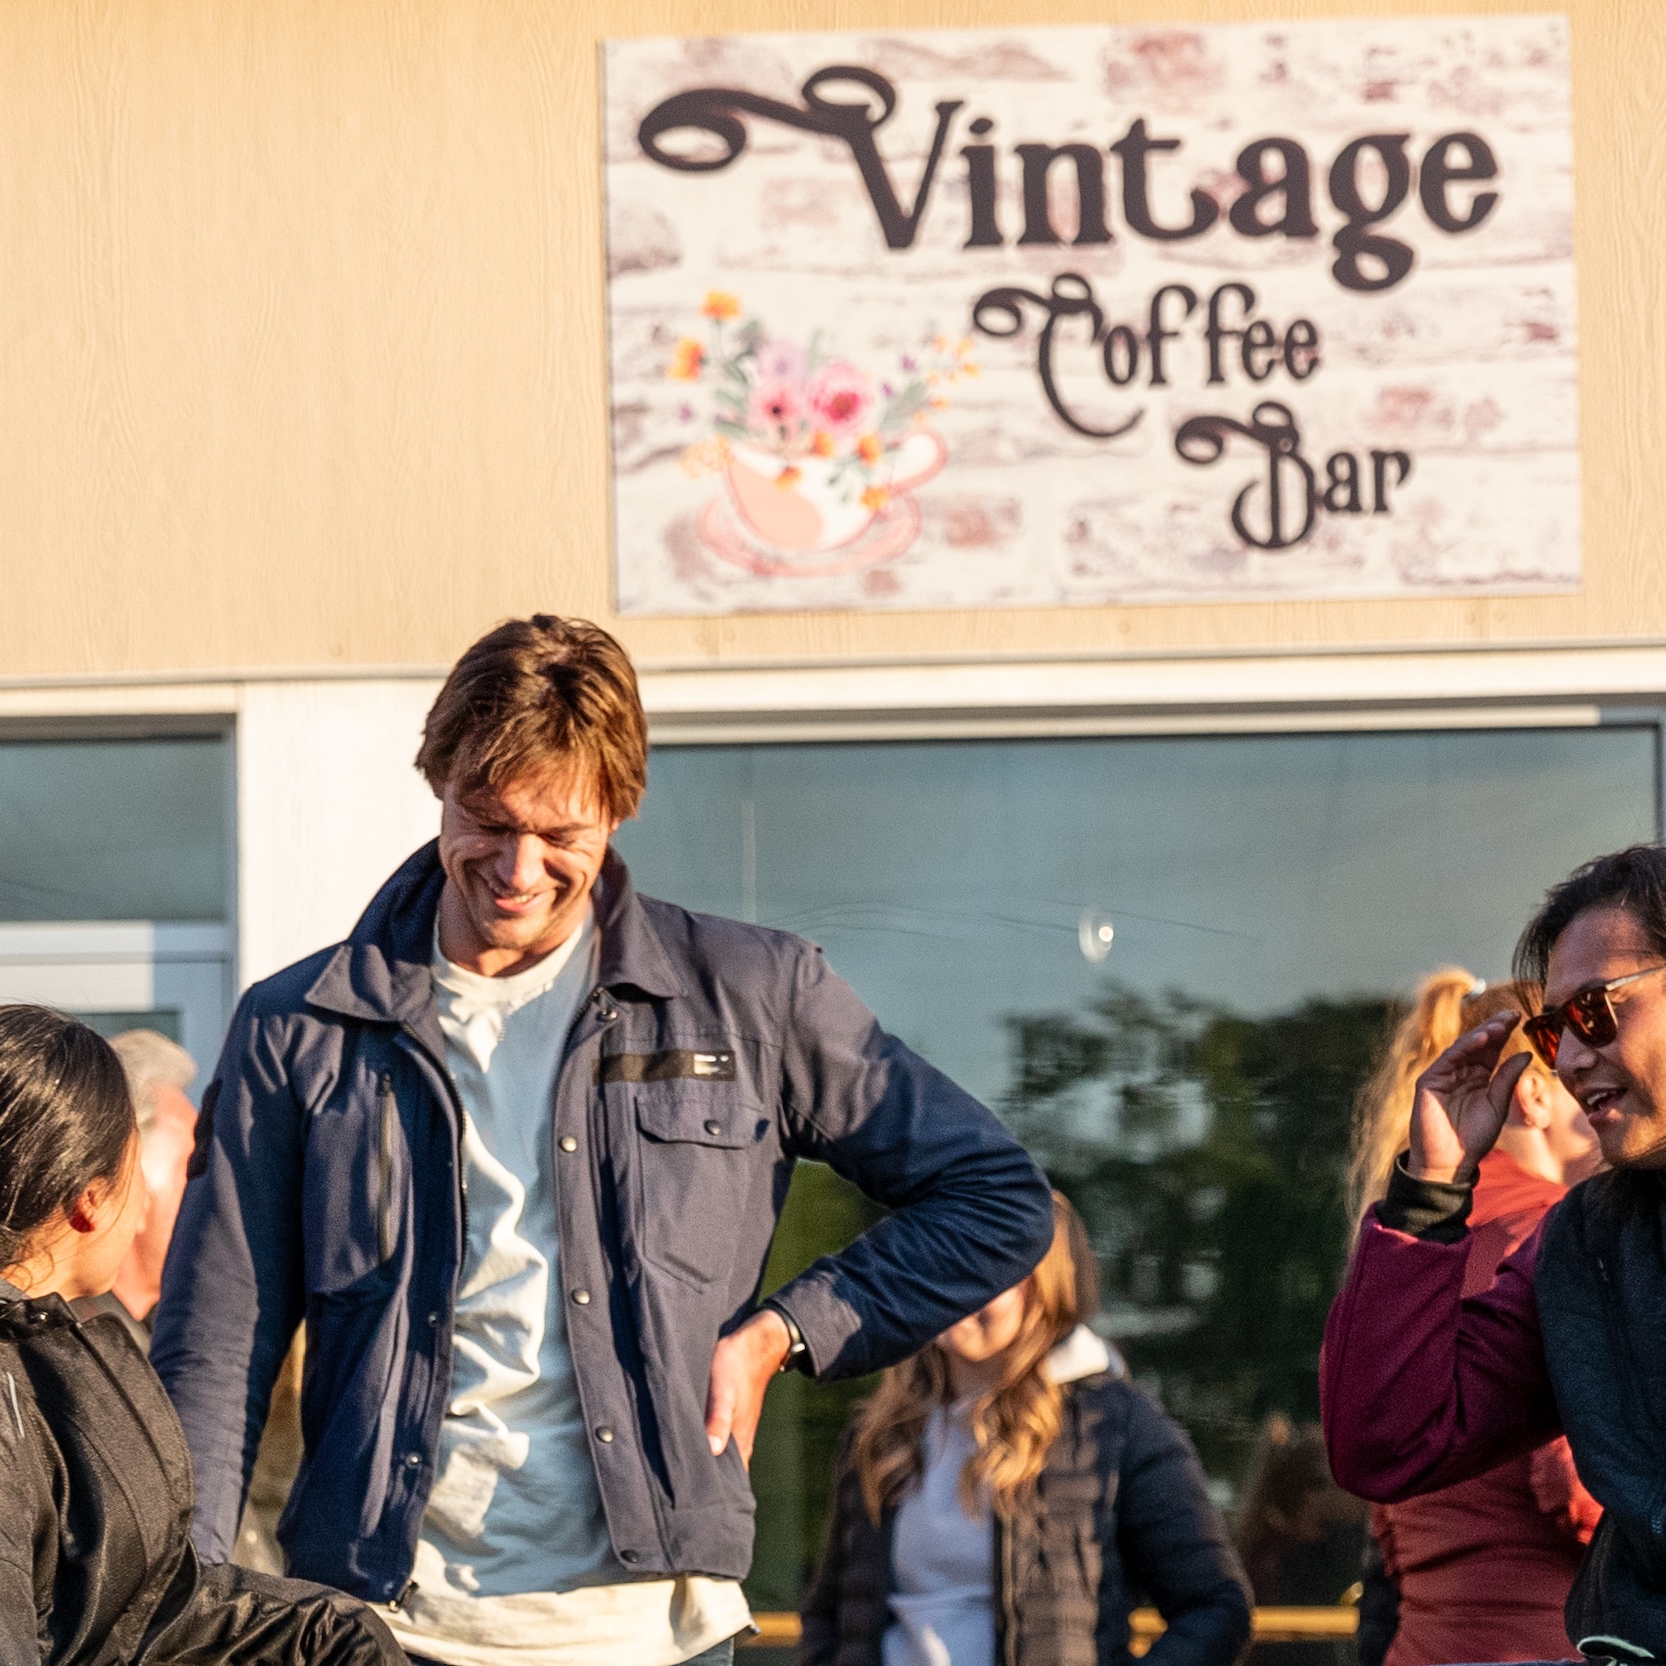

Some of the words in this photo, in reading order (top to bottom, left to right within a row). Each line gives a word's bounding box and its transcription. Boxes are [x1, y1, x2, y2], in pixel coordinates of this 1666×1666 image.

[636, 64, 1502, 294] Vintage
[970, 271, 1321, 439] Coffee
[1173, 400, 1413, 551] Bar
